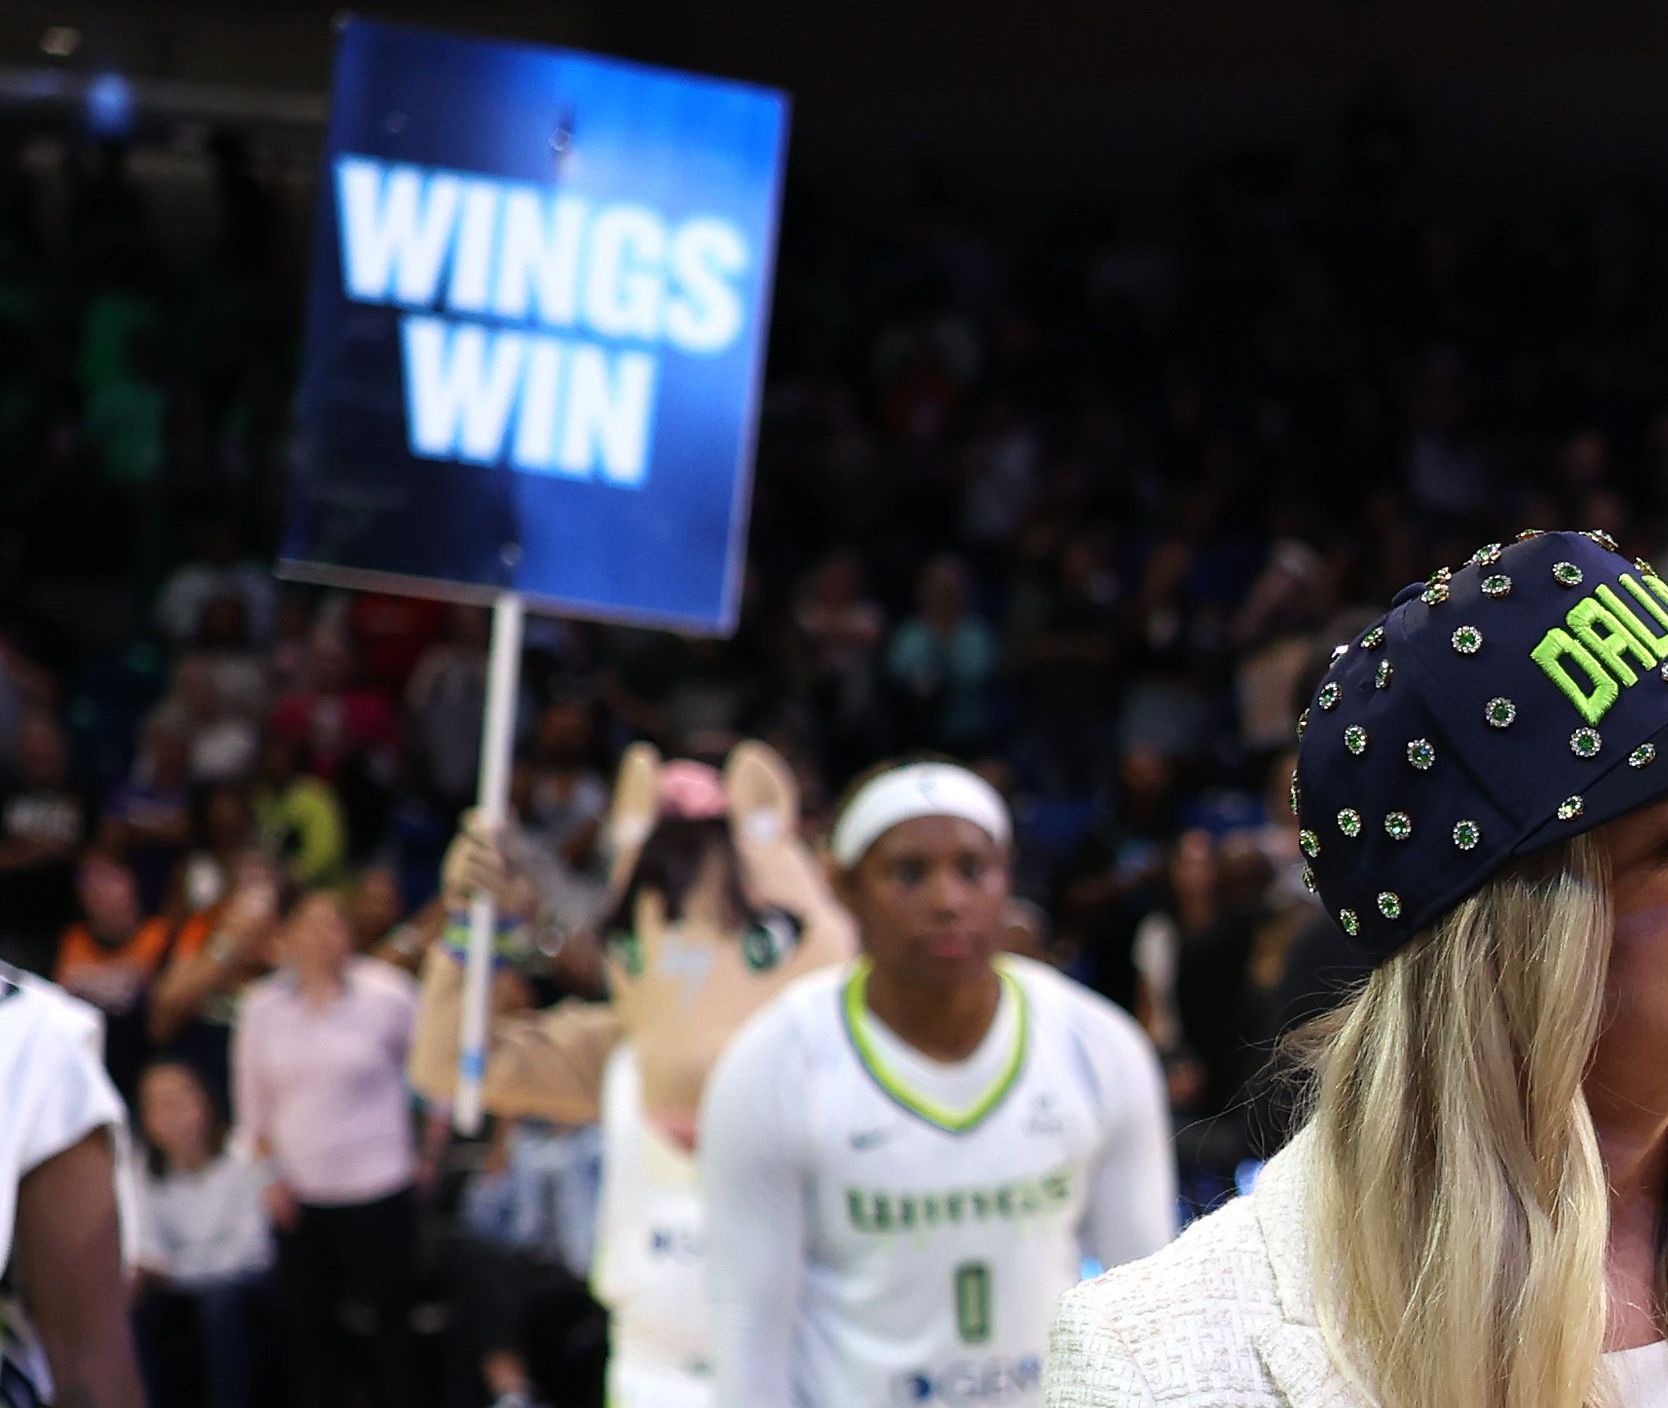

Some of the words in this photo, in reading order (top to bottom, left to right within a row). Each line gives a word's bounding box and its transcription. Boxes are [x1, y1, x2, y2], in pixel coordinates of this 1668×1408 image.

[335, 157, 747, 355] WINGS
[401, 317, 658, 489] WIN
[953, 1258, 995, 1347] 0
